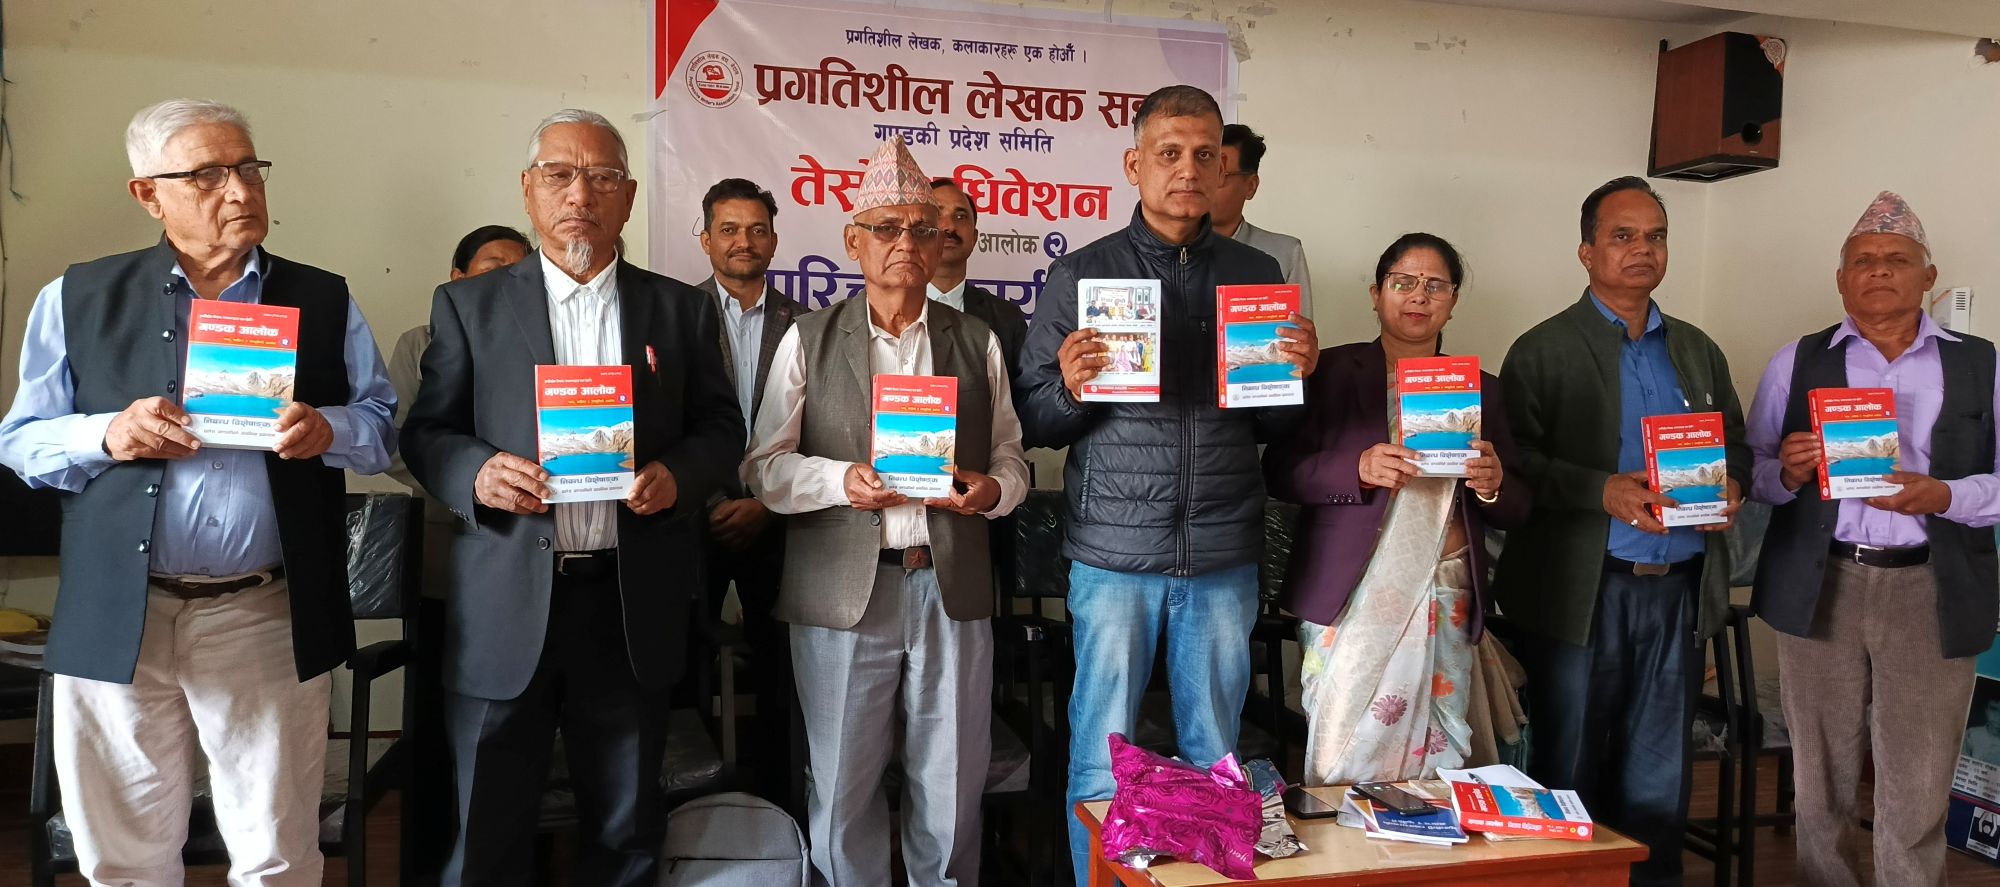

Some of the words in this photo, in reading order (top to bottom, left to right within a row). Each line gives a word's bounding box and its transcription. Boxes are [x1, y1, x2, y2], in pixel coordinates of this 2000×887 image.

[846, 26, 902, 49] प्रगतिशील
[907, 32, 945, 54] लेखक,
[952, 38, 1018, 61] कलाकारहरू
[1023, 45, 1043, 63] एक
[753, 58, 954, 115] प्रगतिशील
[966, 70, 1087, 122] लेखक
[949, 125, 990, 151] प्रदेश
[999, 127, 1054, 154] समिति
[940, 164, 1112, 221] धिवेशन
[978, 229, 1040, 256] आलोक
